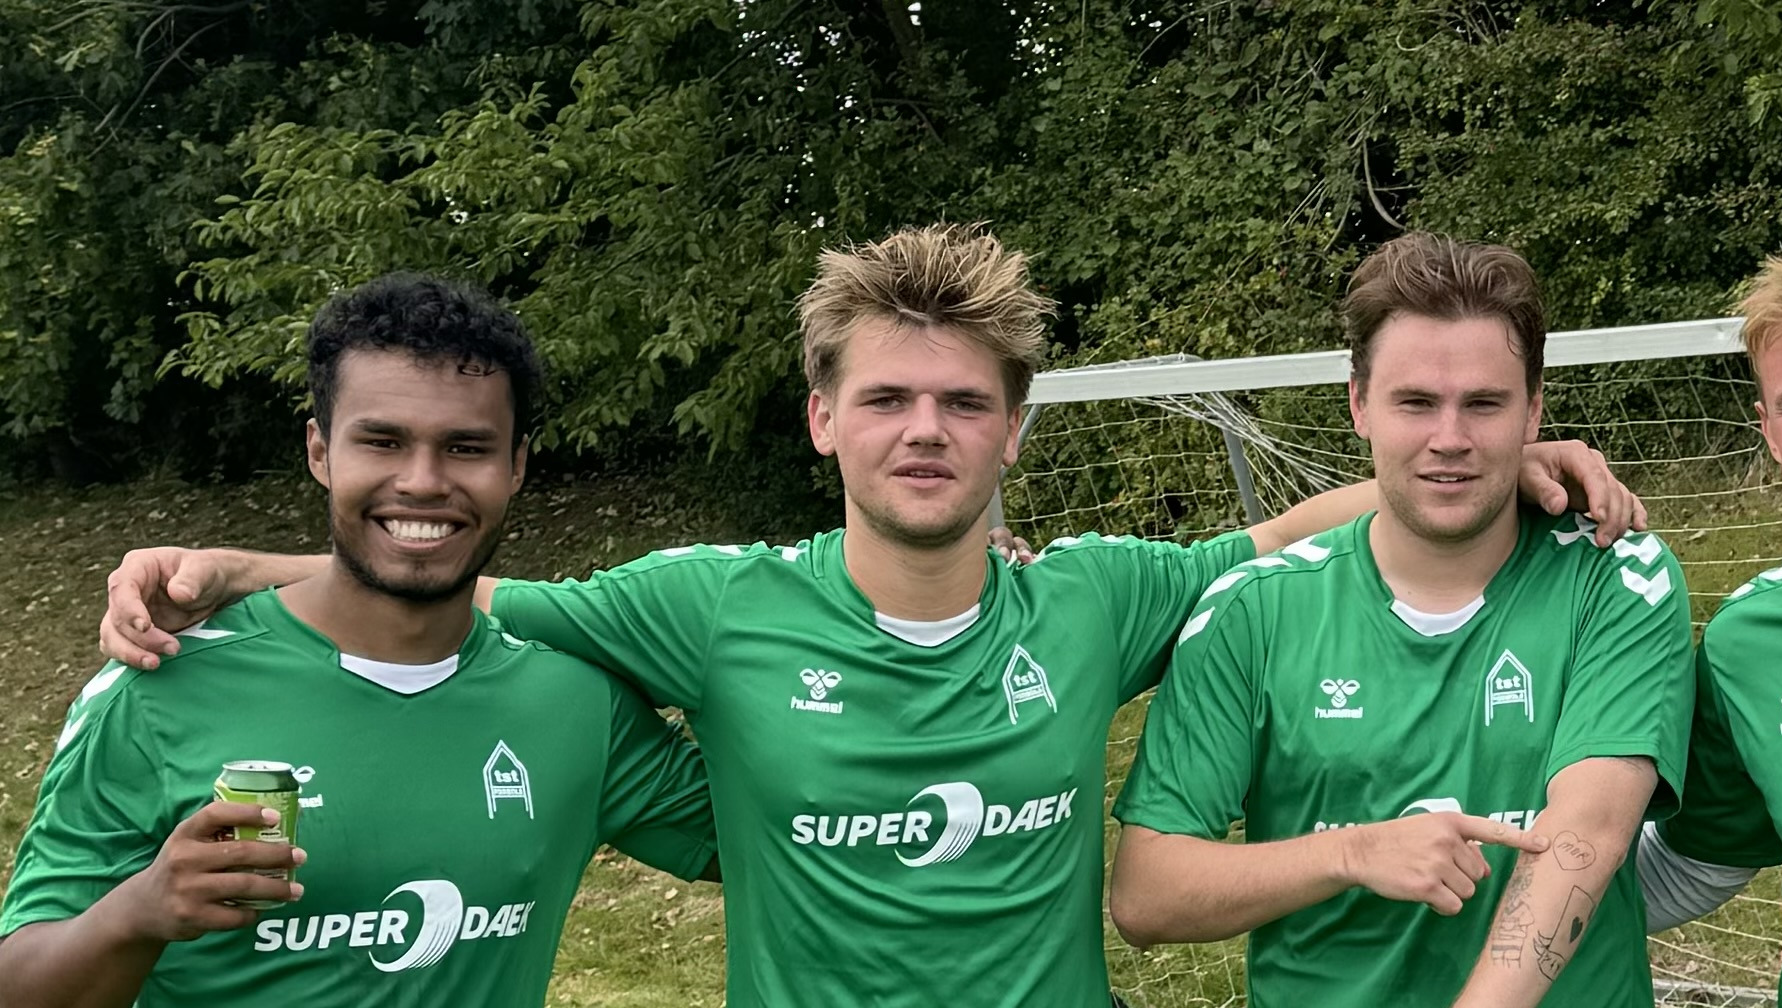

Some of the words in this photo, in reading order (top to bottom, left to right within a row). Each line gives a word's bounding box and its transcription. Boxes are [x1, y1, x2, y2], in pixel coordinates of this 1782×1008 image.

[791, 811, 932, 847] SUPER
[982, 787, 1078, 837] DAEK
[254, 910, 409, 951] SUPER
[460, 901, 536, 940] DAEK
